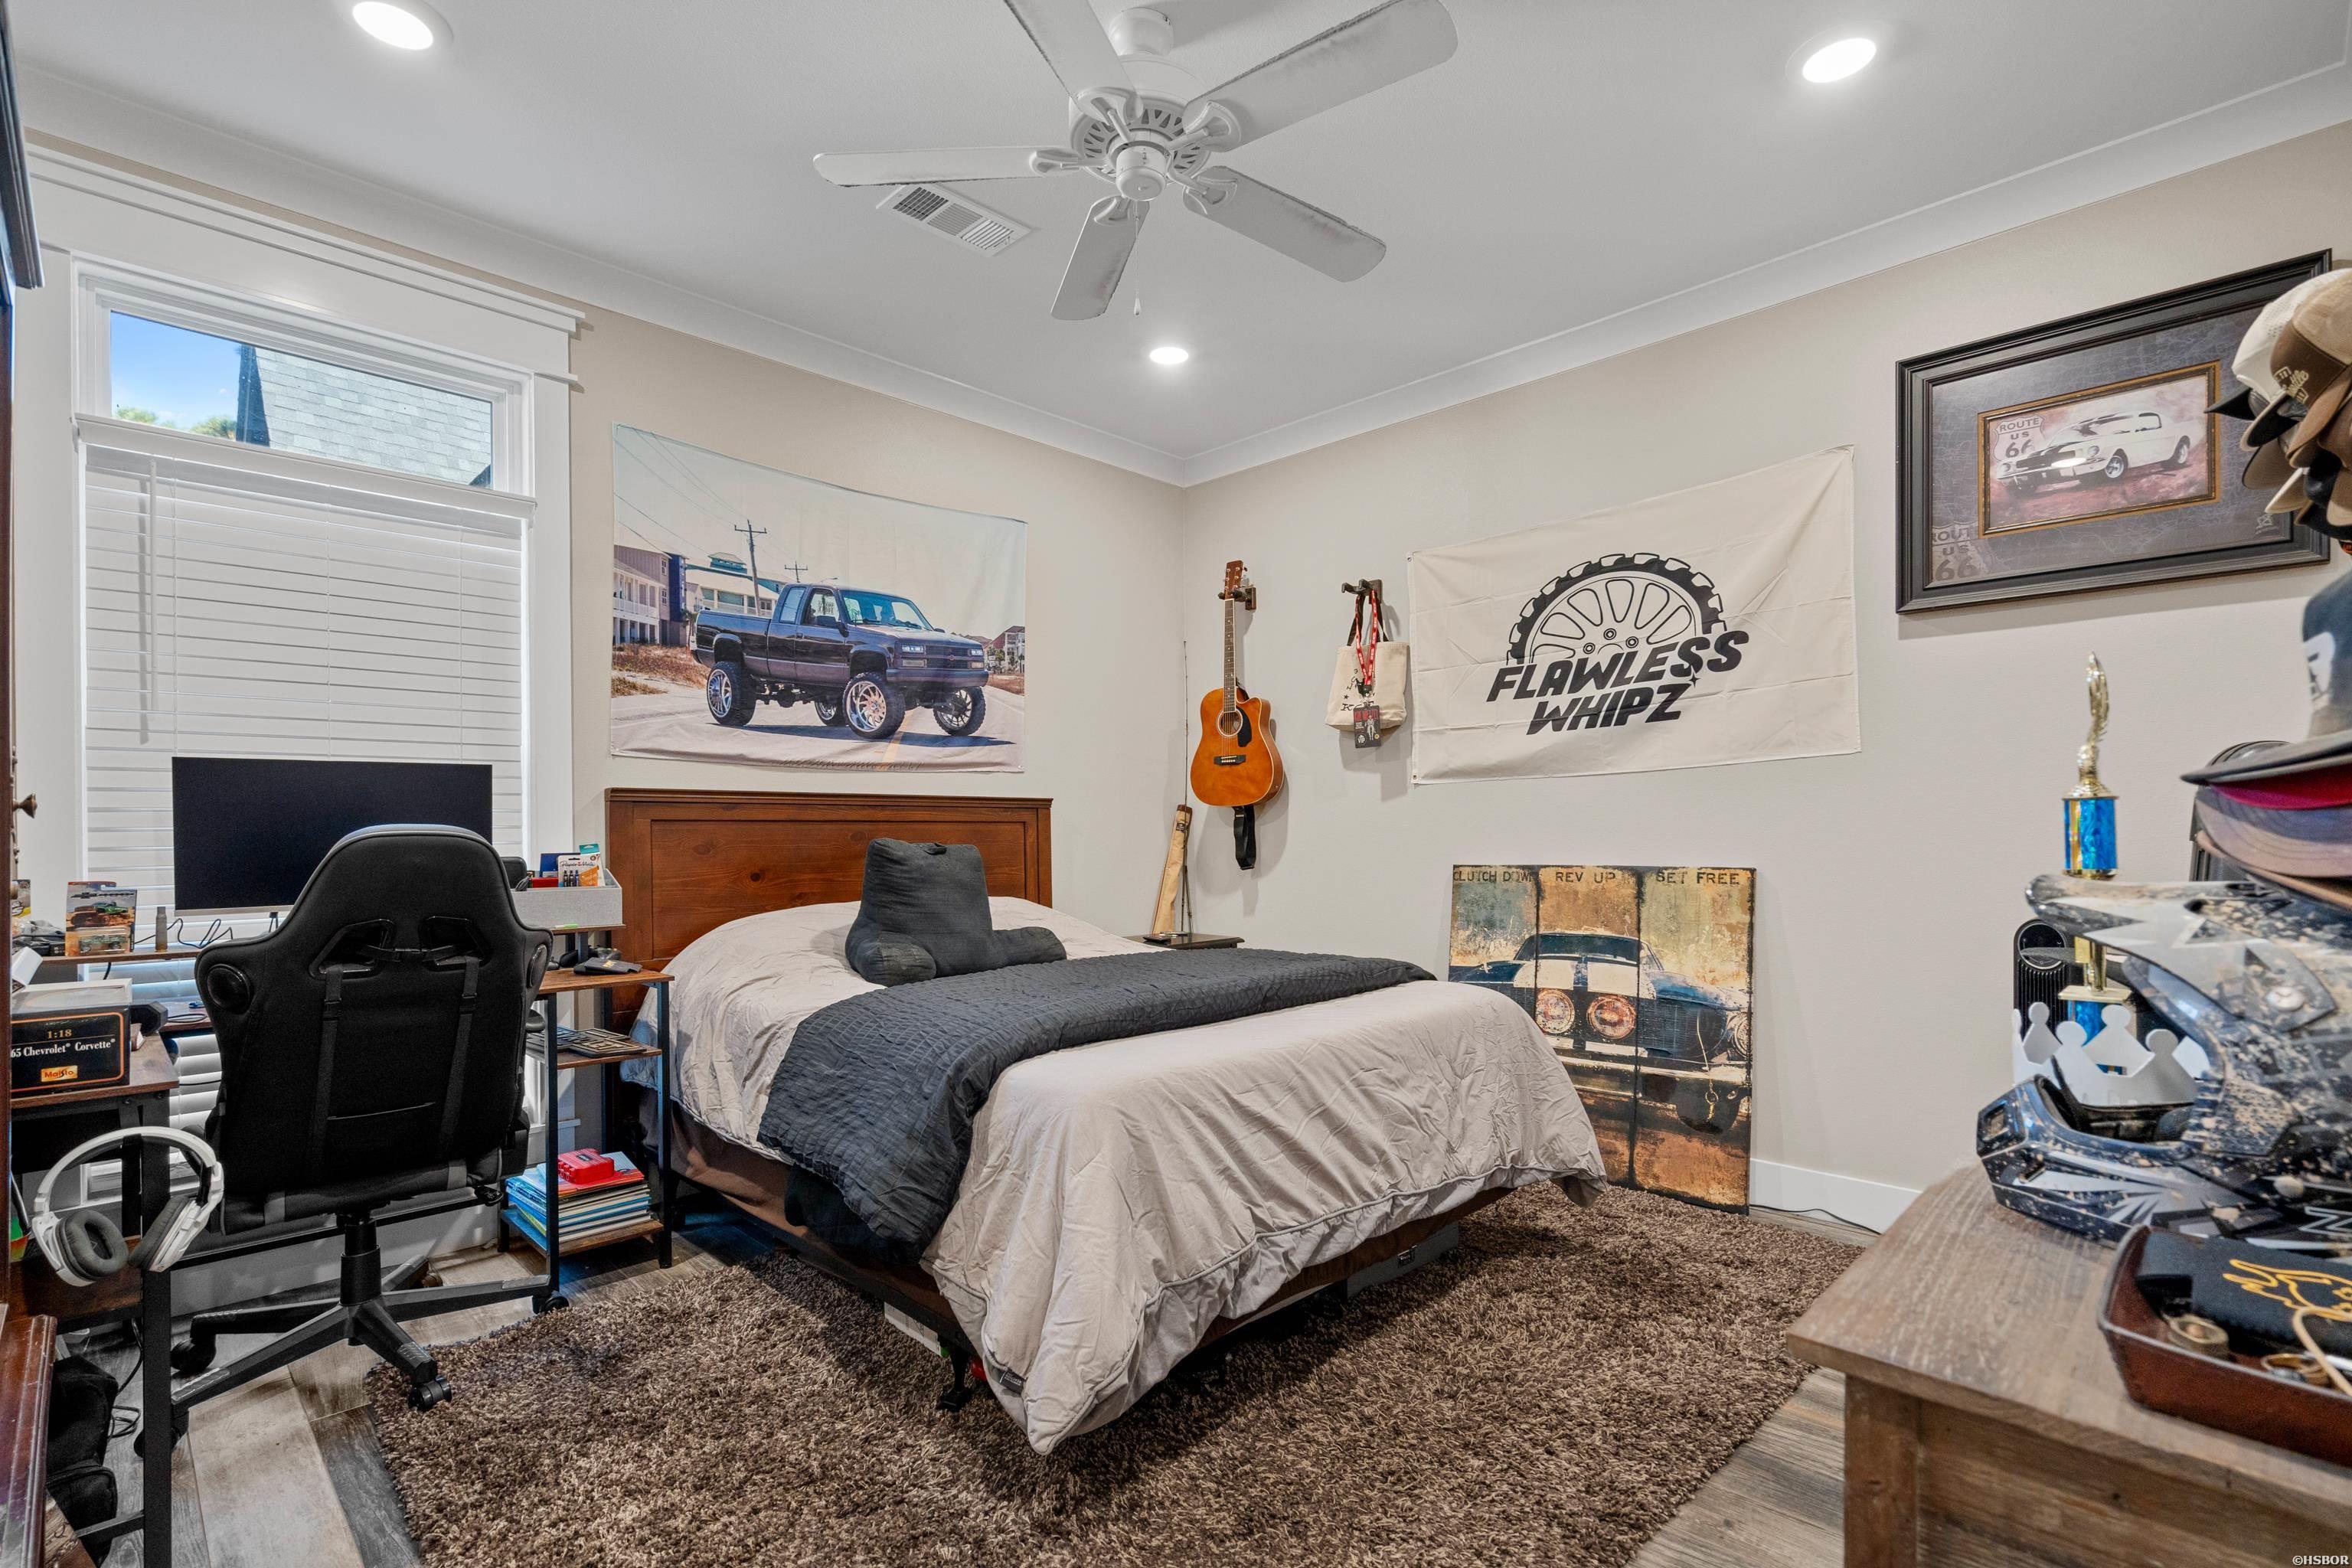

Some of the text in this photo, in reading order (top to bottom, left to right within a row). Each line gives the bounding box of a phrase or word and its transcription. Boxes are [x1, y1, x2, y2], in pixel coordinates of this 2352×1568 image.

[1999, 417, 2040, 433] ROUTE
[2011, 431, 2030, 439] US
[2006, 439, 2035, 458] 66
[1486, 630, 1749, 702] FLAWLESS
[1526, 683, 1692, 735] WHIPZ
[1453, 870, 1497, 882] CLUTCH
[1555, 871, 1616, 884] REV UP
[1655, 871, 1740, 885] SET FREE
[47, 1029, 72, 1039] 1:18
[44, 1068, 74, 1078] Maisto
